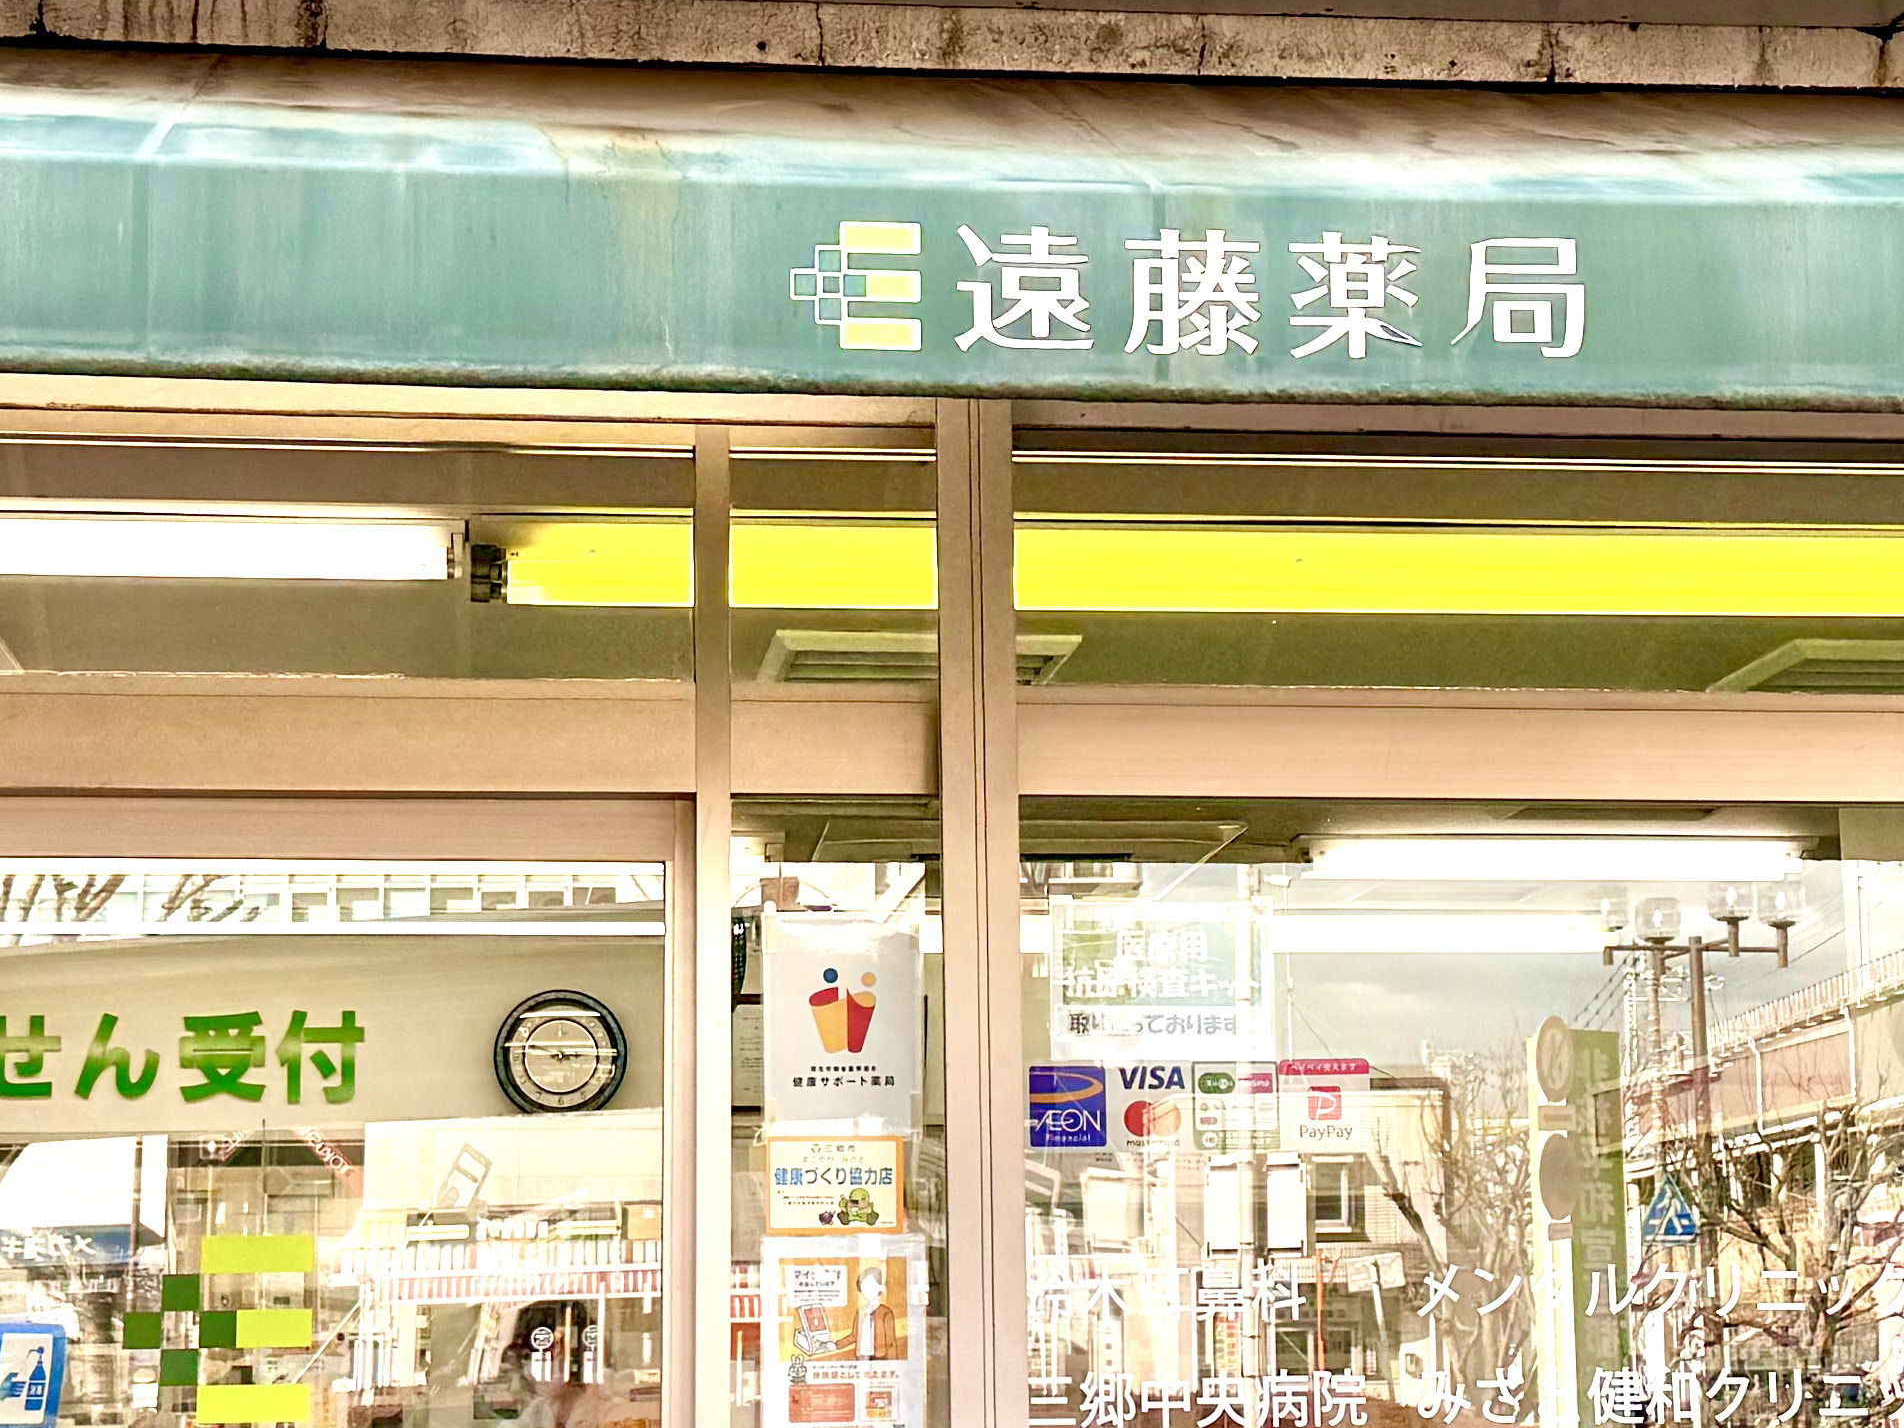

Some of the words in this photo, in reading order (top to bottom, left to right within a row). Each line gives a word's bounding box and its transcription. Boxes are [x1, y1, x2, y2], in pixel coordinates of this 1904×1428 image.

[955, 224, 1586, 359] 遠藤薬局
[1119, 1066, 1185, 1089] VISA
[1299, 1125, 1354, 1141] PayPay
[774, 1167, 893, 1186] 健康づくり協力店
[1028, 1368, 1369, 1428] 三郷中央病院
